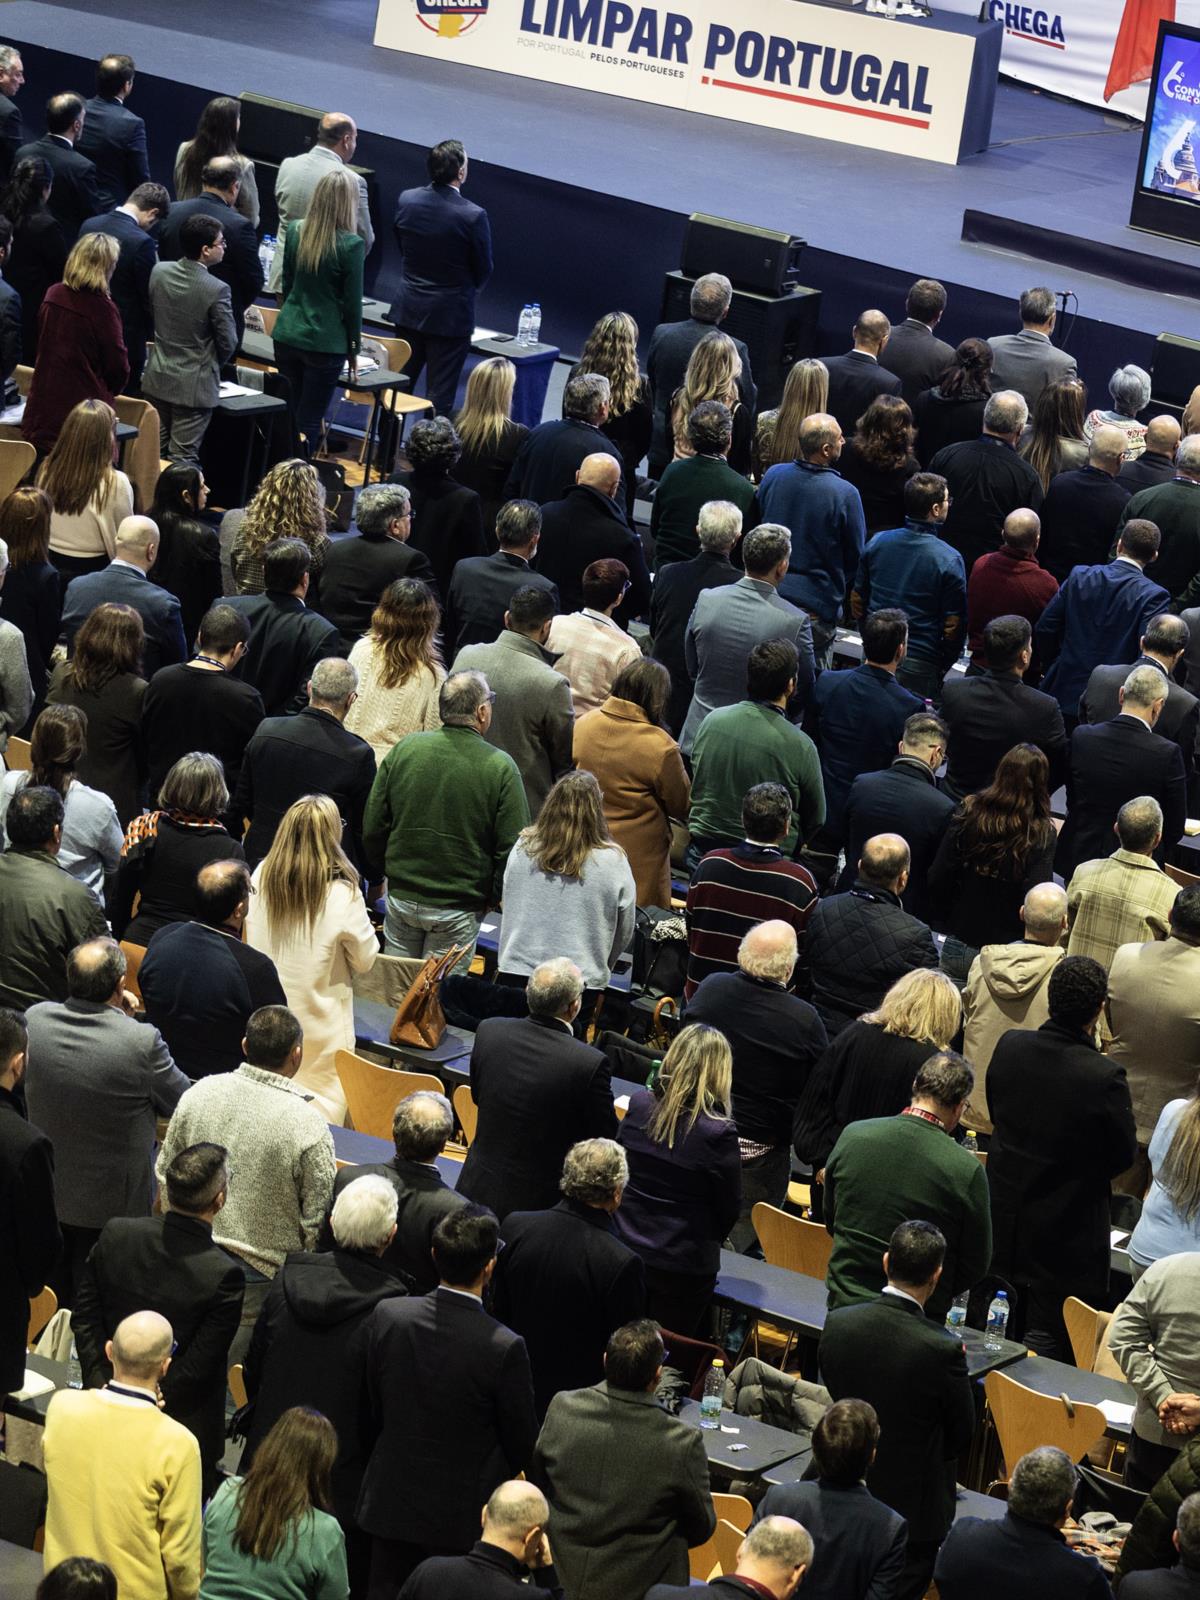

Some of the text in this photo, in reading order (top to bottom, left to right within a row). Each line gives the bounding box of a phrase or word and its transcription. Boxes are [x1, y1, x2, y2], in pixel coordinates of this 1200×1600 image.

[989, 0, 1065, 43] CHEGA
[517, 37, 685, 79] POR PORTUGAL PELOS PORTUGUESES
[519, 0, 933, 115] LIMPAR PORTUGAL
